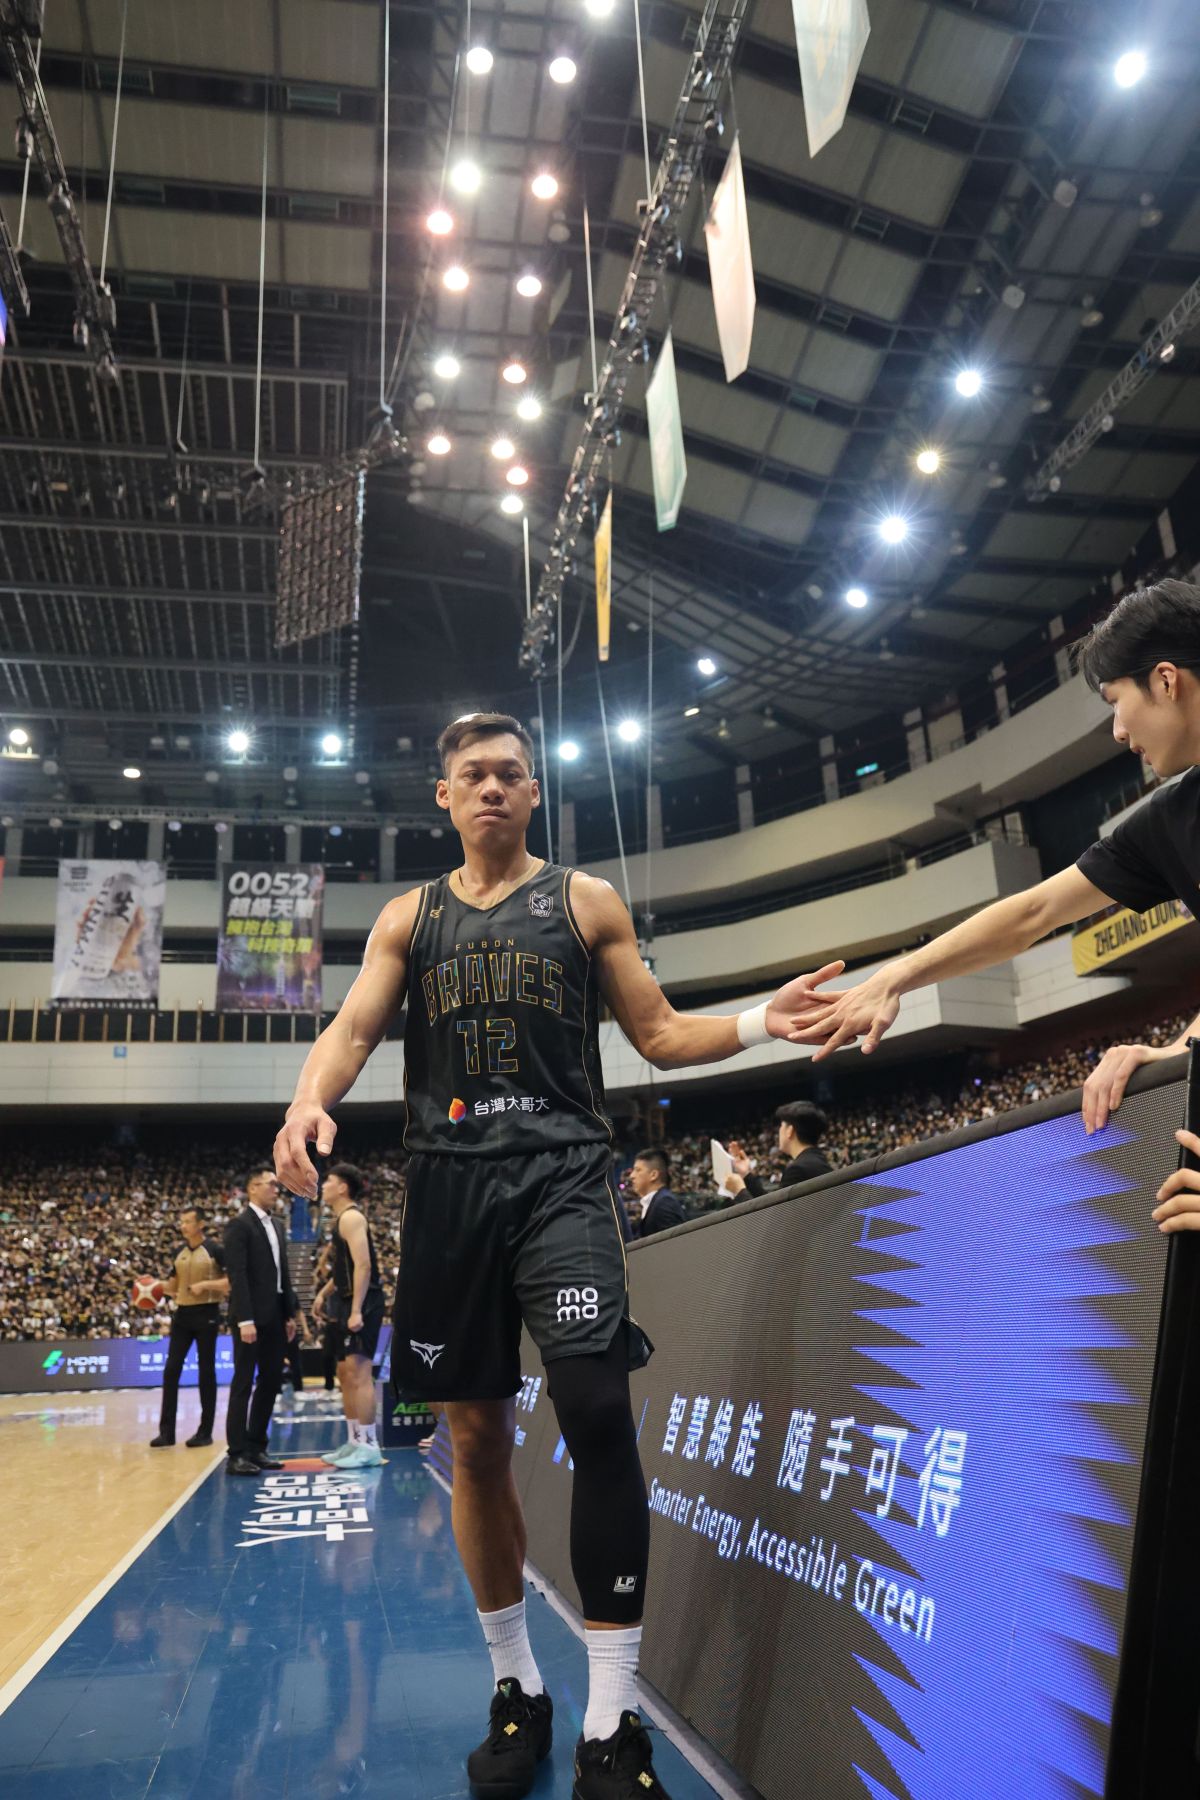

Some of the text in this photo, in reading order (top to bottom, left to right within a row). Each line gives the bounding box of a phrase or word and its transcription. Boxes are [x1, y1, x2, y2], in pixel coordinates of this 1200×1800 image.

[228, 871, 309, 896] 0052
[455, 938, 514, 951] FUBON
[421, 952, 563, 1027] BRAVES
[456, 1017, 519, 1075] 12
[474, 1095, 550, 1117] 台灣大哥大
[661, 1391, 968, 1538] 智慧綠能 隨手可得
[616, 1576, 635, 1587] LP
[648, 1477, 936, 1645] Smarter Energy, Accessible Green
